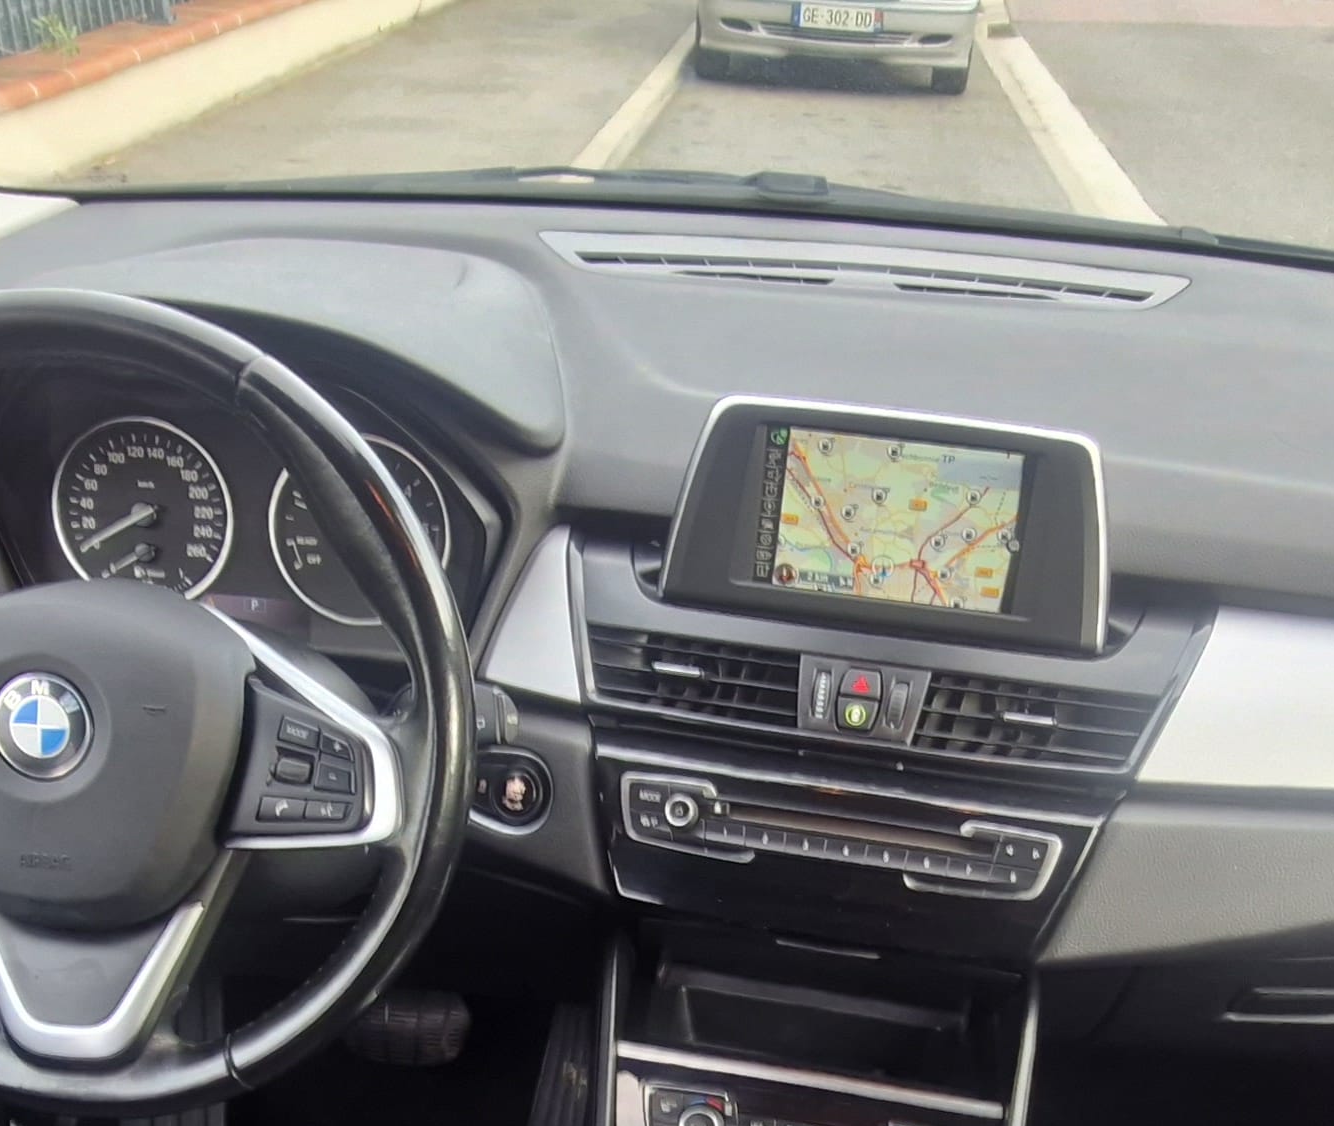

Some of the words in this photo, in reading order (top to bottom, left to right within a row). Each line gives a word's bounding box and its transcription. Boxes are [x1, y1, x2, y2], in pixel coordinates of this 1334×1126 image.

[107, 452, 125, 464] 100
[127, 446, 144, 458] 120
[147, 447, 164, 459] 140
[167, 455, 184, 468] 160
[94, 464, 107, 476] 80
[181, 469, 198, 482] 180
[84, 479, 98, 491] 60
[188, 488, 208, 500] 200
[80, 497, 94, 510] 40
[194, 510, 213, 520] 220
[82, 516, 96, 529] 20
[193, 529, 213, 538] 240
[186, 544, 206, 557] 260
